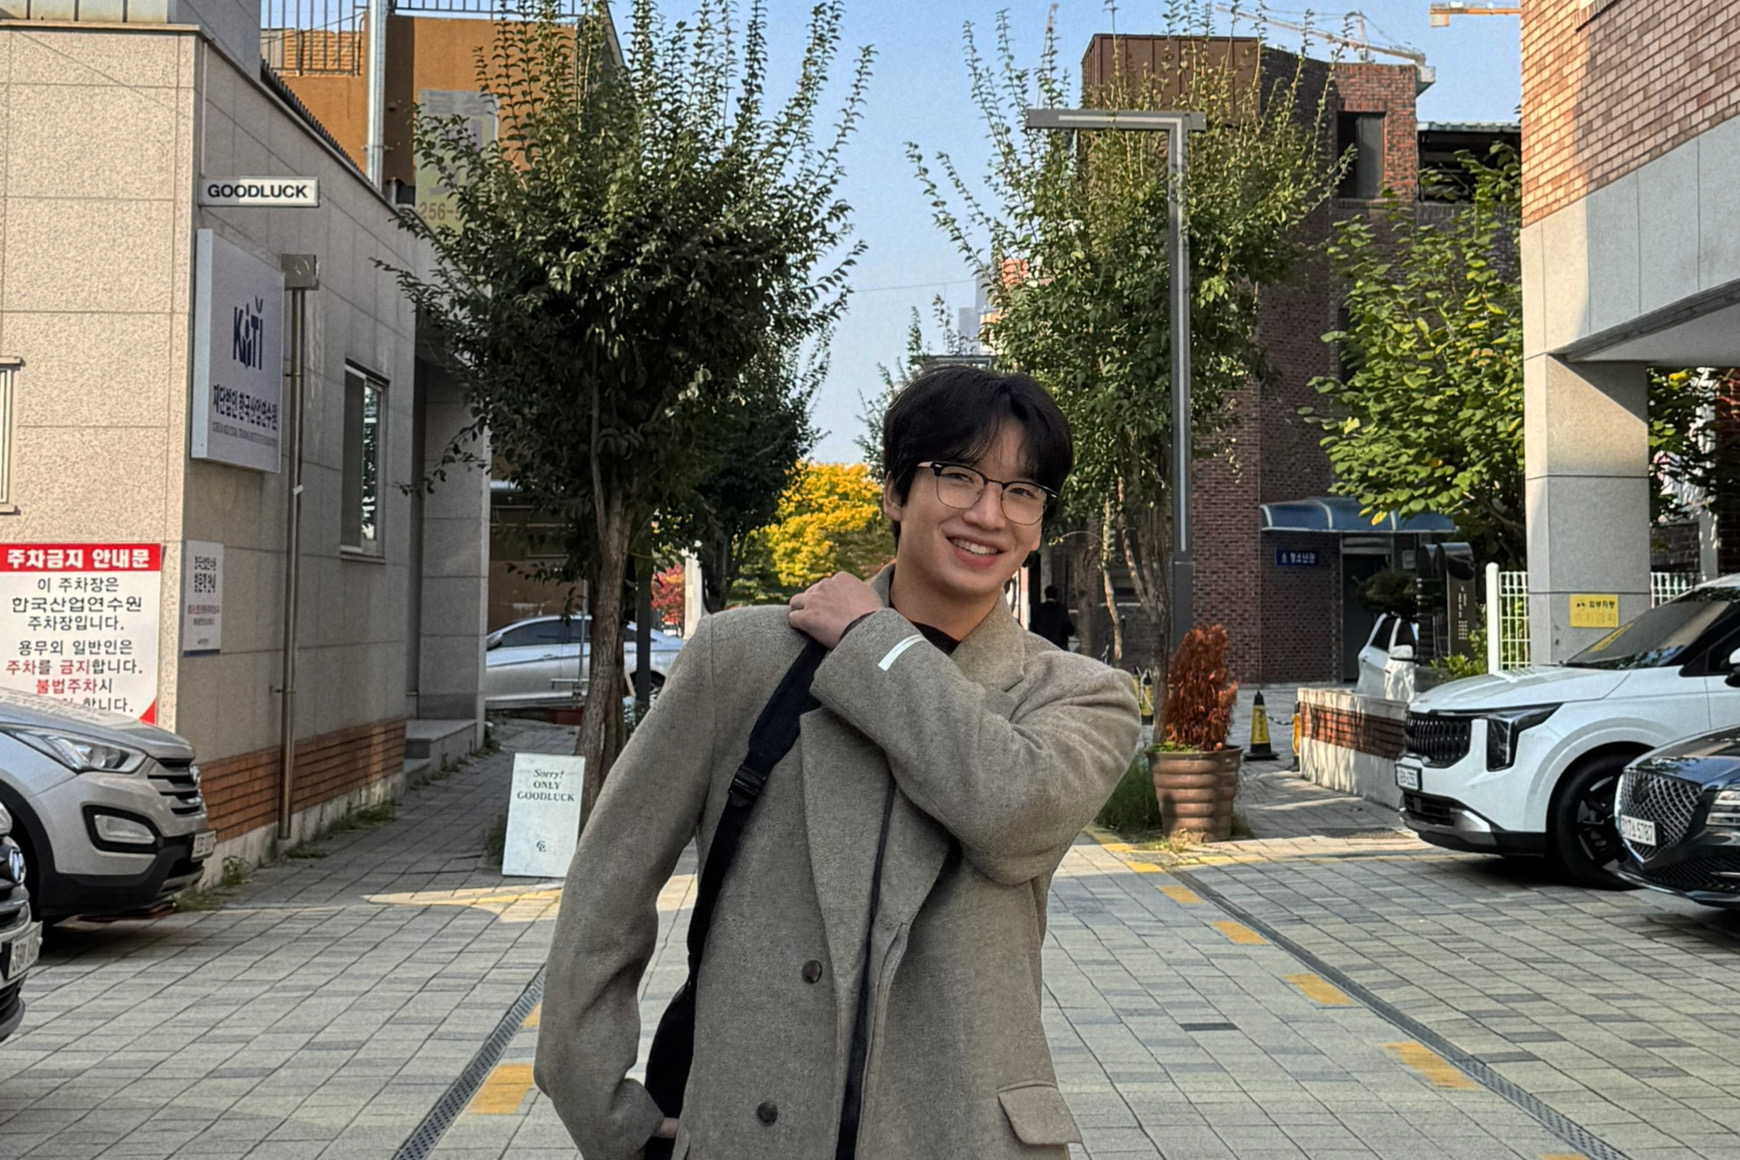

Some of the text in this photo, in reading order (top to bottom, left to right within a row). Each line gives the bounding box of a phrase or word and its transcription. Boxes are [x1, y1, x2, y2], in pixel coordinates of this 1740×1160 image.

[207, 184, 307, 198] GOODLUCK
[7, 549, 149, 568] 주차금지 안내문
[37, 577, 119, 593] 이 주차장은
[12, 596, 142, 613] 한국산업연수원
[27, 615, 125, 631] 주차장입니다.
[18, 640, 133, 657] 용무외 일반인은
[6, 659, 143, 676] 주차를 금지합니다.
[36, 678, 112, 694] 불법주차시
[533, 769, 565, 779] Sorry!
[533, 781, 561, 790] ONLY
[517, 791, 575, 802] GOODLUCK
